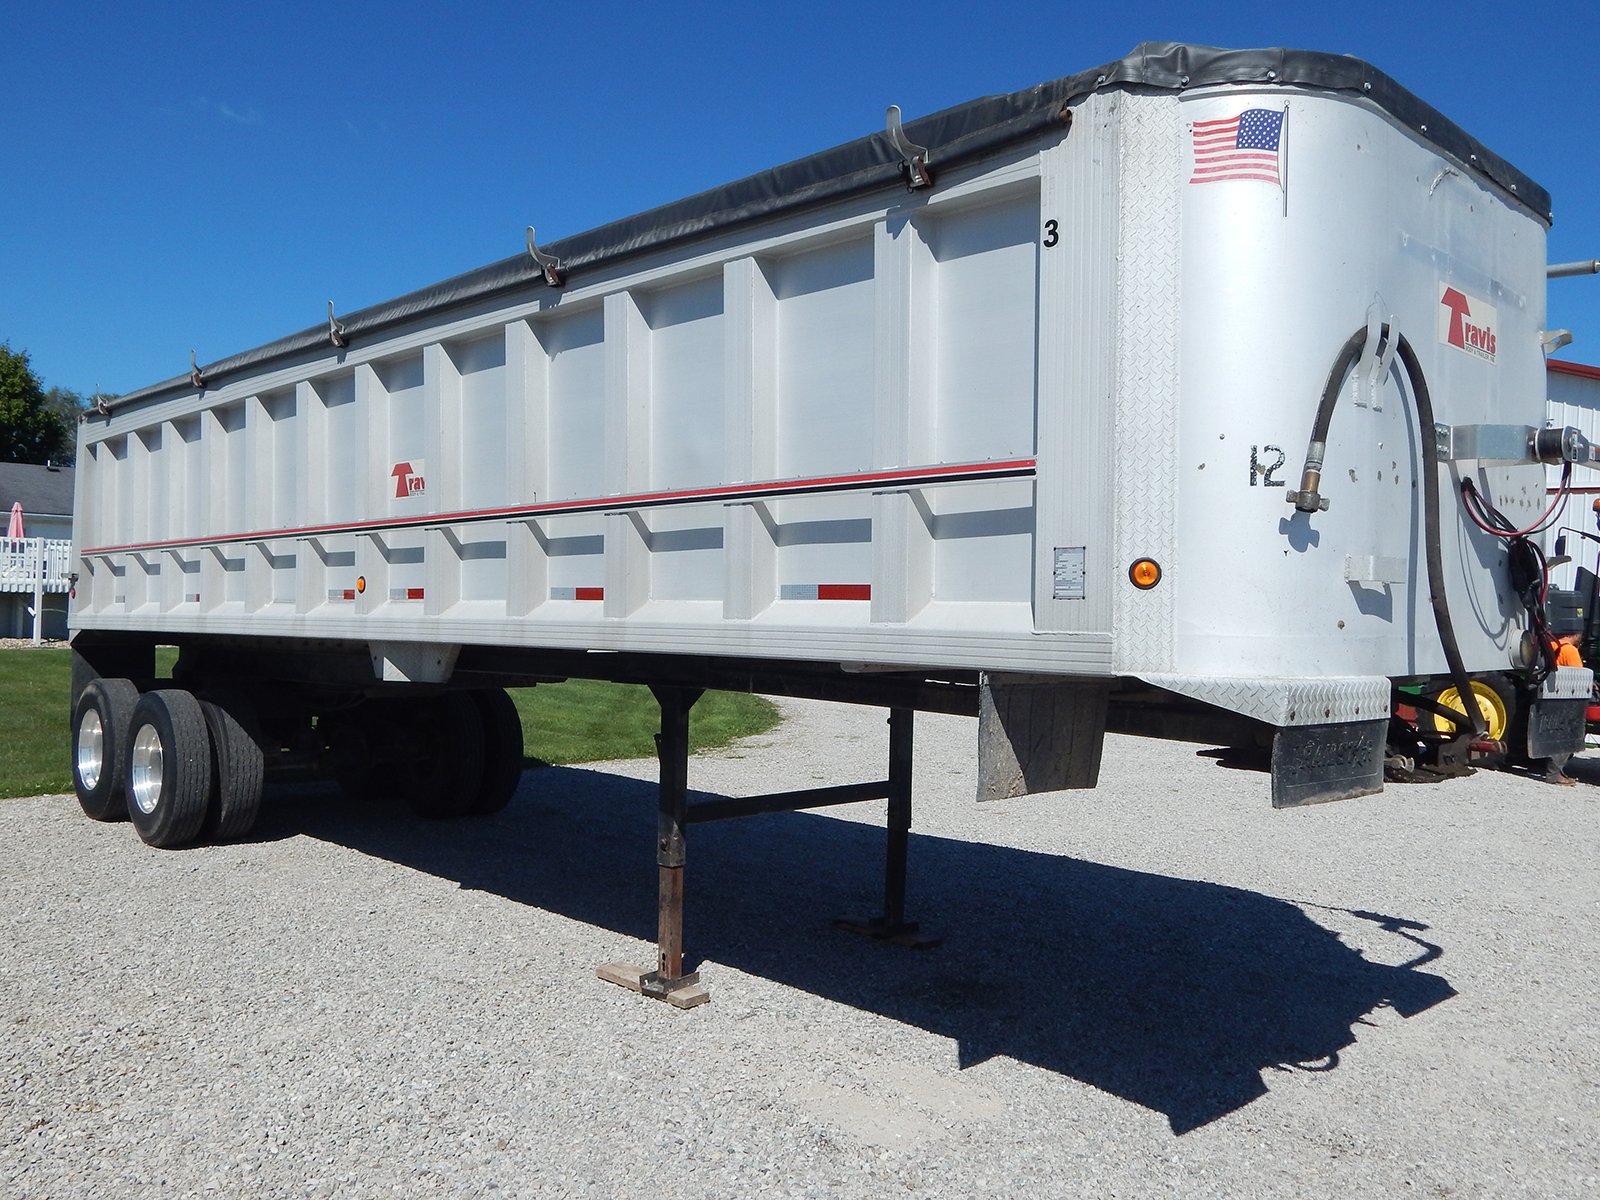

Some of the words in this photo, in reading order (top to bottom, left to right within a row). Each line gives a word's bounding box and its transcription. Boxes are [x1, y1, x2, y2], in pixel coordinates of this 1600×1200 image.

[1043, 219, 1059, 247] 3
[1441, 286, 1496, 354] Travis
[1250, 445, 1286, 487] 12
